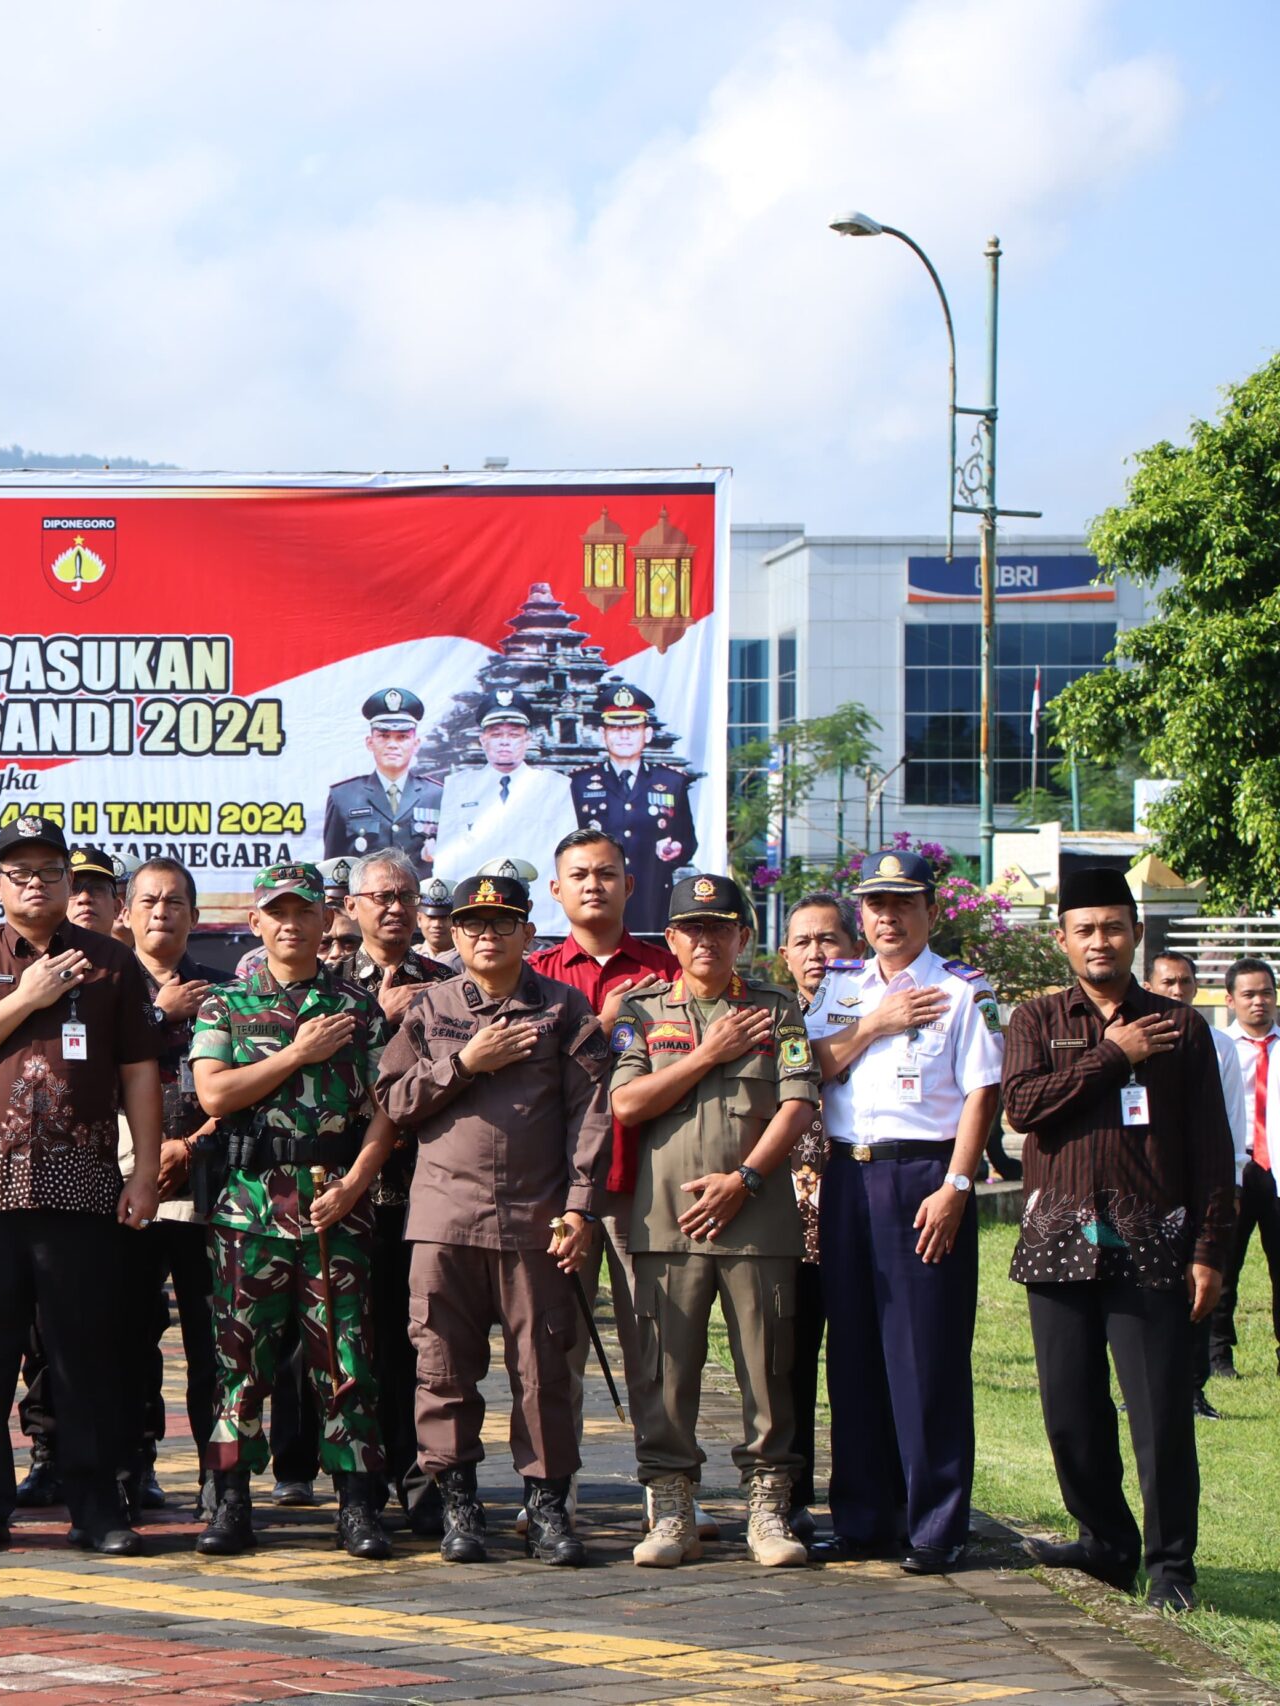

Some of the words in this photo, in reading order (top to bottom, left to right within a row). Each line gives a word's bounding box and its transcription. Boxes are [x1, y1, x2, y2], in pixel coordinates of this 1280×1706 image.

[43, 518, 116, 529] DIPONEGORO
[1000, 565, 1038, 587] BRI
[140, 699, 285, 753] 2024
[73, 802, 97, 834] H
[104, 802, 211, 834] TAHUN
[218, 802, 306, 834] 2024
[651, 1041, 691, 1051] AHMAD
